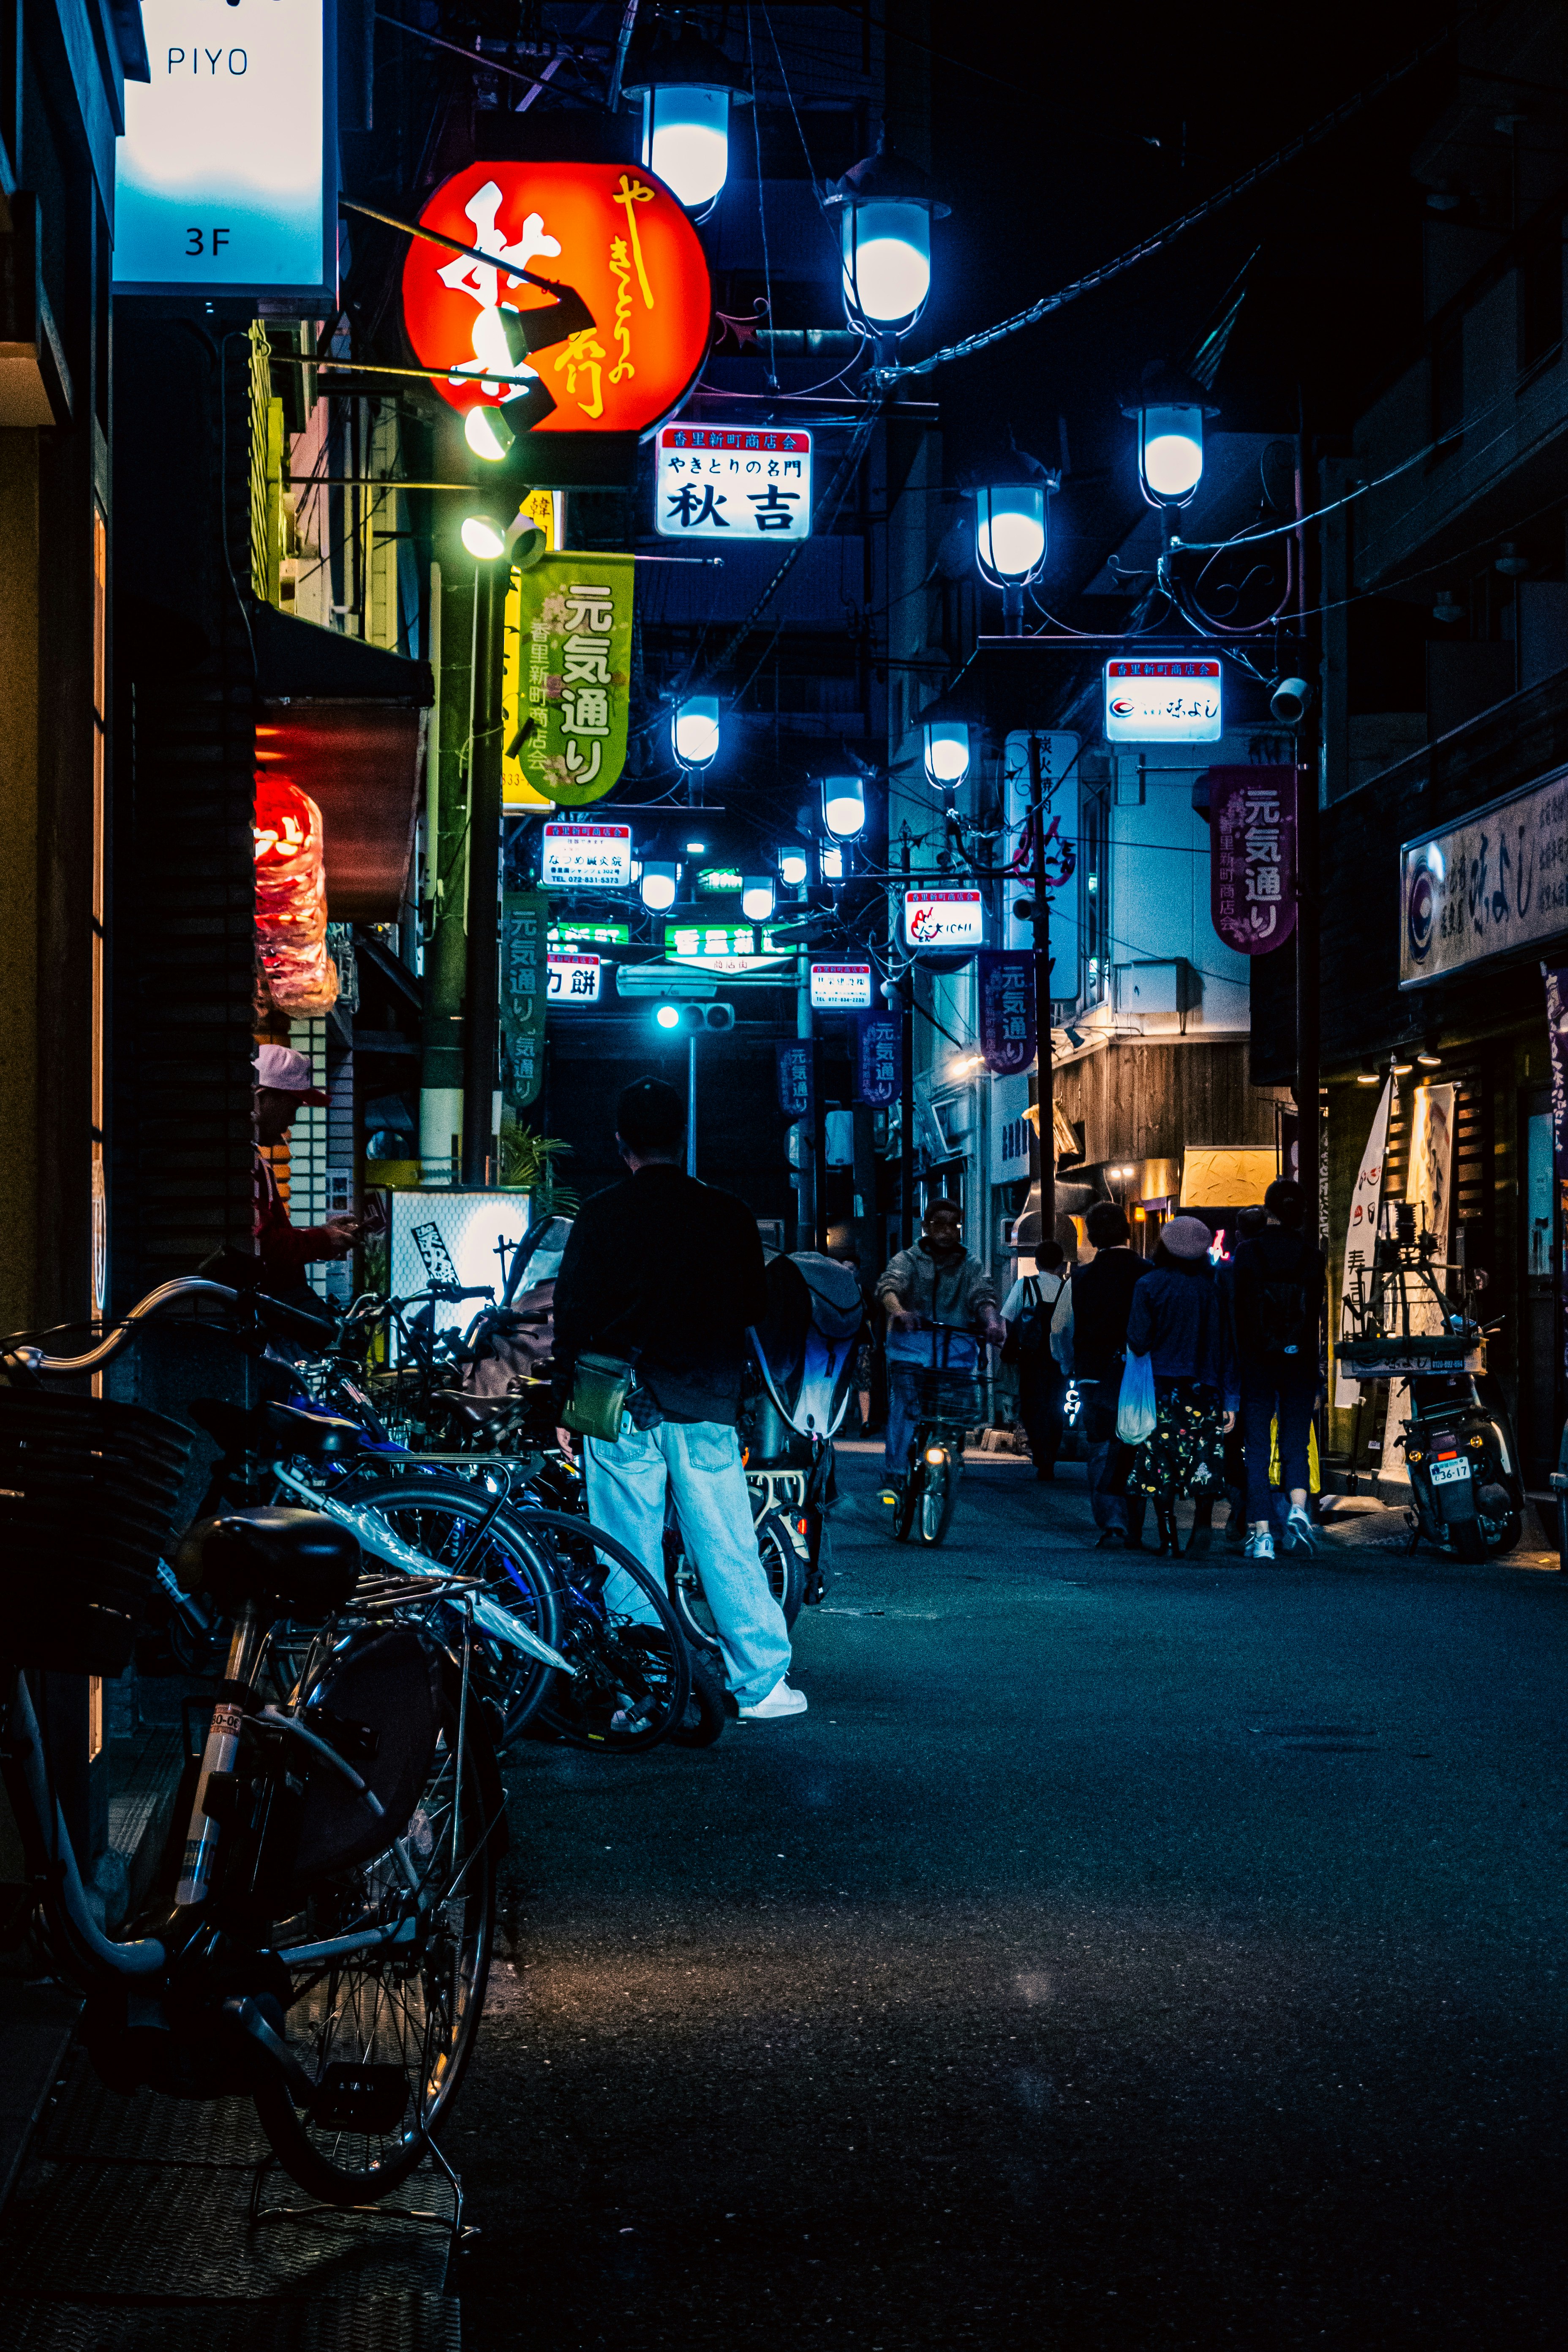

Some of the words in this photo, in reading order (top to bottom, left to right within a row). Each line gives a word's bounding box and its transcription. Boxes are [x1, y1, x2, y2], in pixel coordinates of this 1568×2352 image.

[169, 48, 247, 74] PIYO
[185, 228, 230, 256] 3F
[674, 430, 797, 450] 香里新町商店会
[668, 457, 801, 478] やきとりの名門
[667, 482, 800, 531] 秋吉
[561, 585, 614, 785] 元気通り
[1118, 664, 1209, 675] 香里新町商店会
[503, 773, 529, 786] 833-
[1245, 790, 1282, 938] 元気通り
[509, 910, 537, 1022] 元気通り
[1002, 966, 1027, 1064] 元気通り
[514, 1028, 535, 1099] 気通り
[792, 1048, 808, 1112] 元気通り
[876, 1023, 894, 1099] 元気通り
[1348, 1249, 1366, 1304] 寿司
[1440, 1466, 1466, 1480] 36-17
